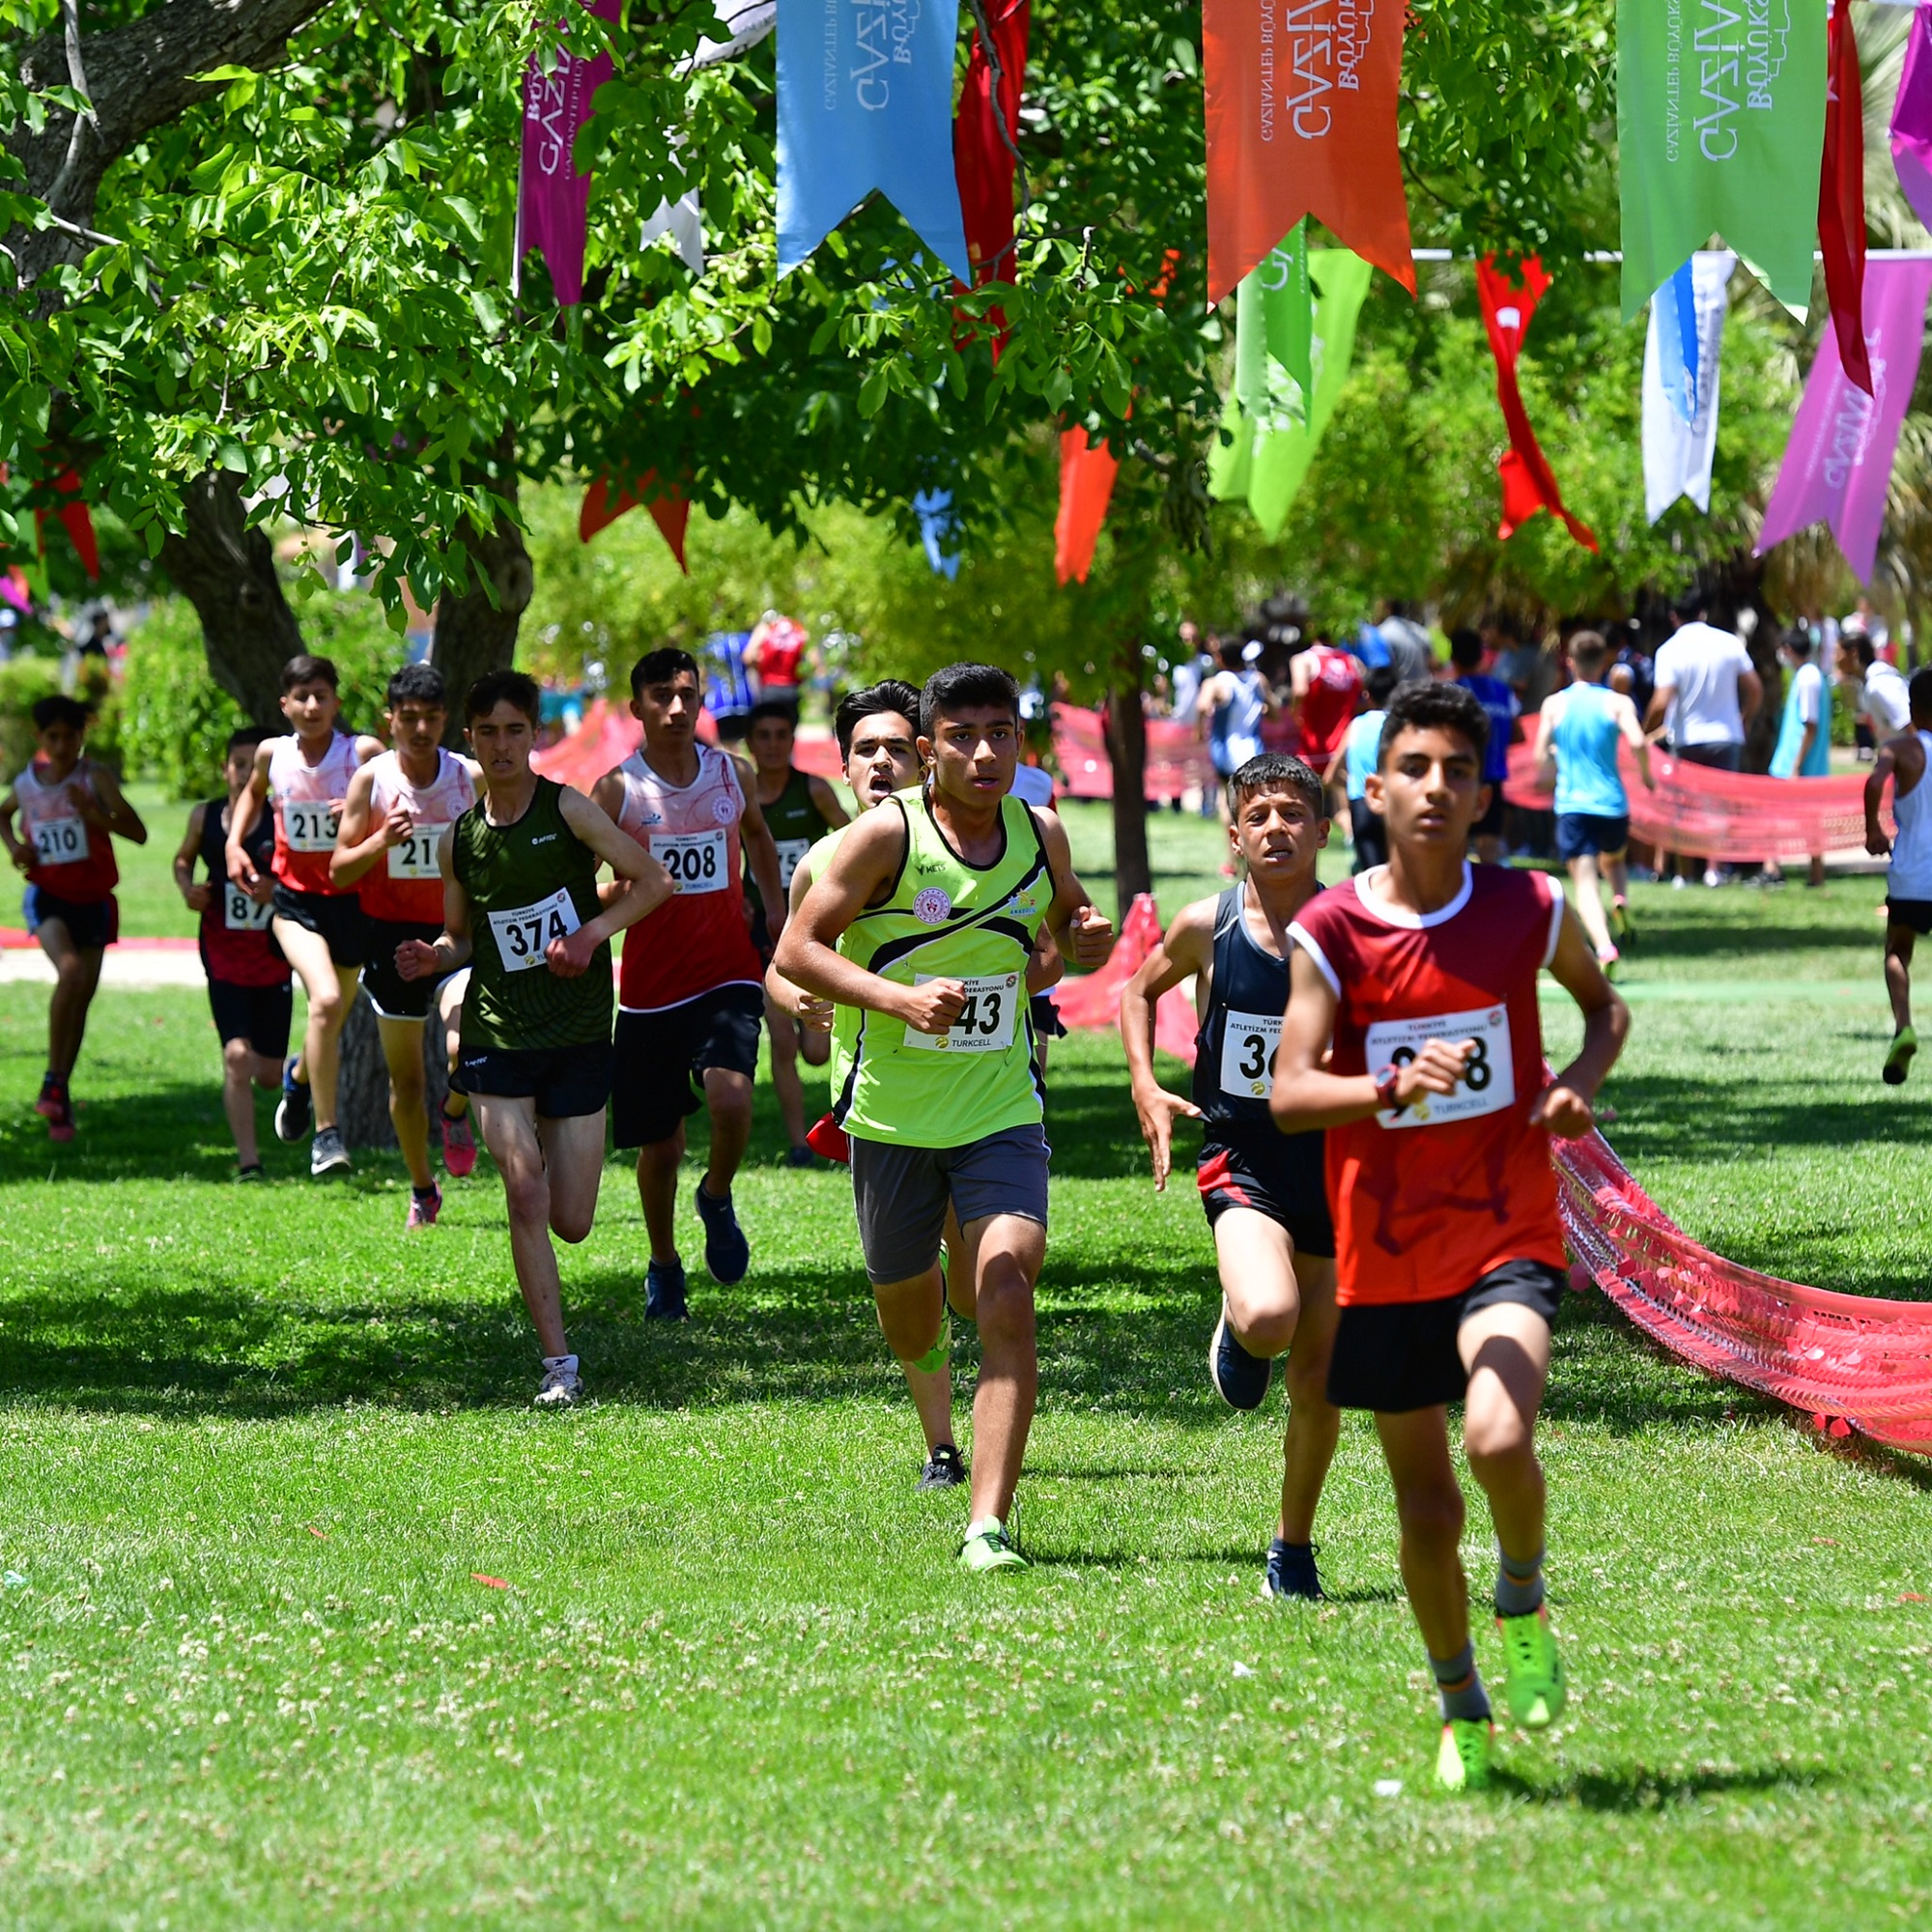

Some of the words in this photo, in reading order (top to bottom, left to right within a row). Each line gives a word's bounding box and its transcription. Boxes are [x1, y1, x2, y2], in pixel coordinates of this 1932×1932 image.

[293, 814, 338, 838] 213
[40, 827, 77, 855] 210
[663, 845, 716, 881] 208
[506, 910, 568, 956] 374
[963, 984, 1005, 993] DERASYONU
[1230, 1022, 1267, 1034] ATLETİZM
[952, 1038, 992, 1048] TURKCELL
[1435, 1097, 1488, 1114] TURKCELL
